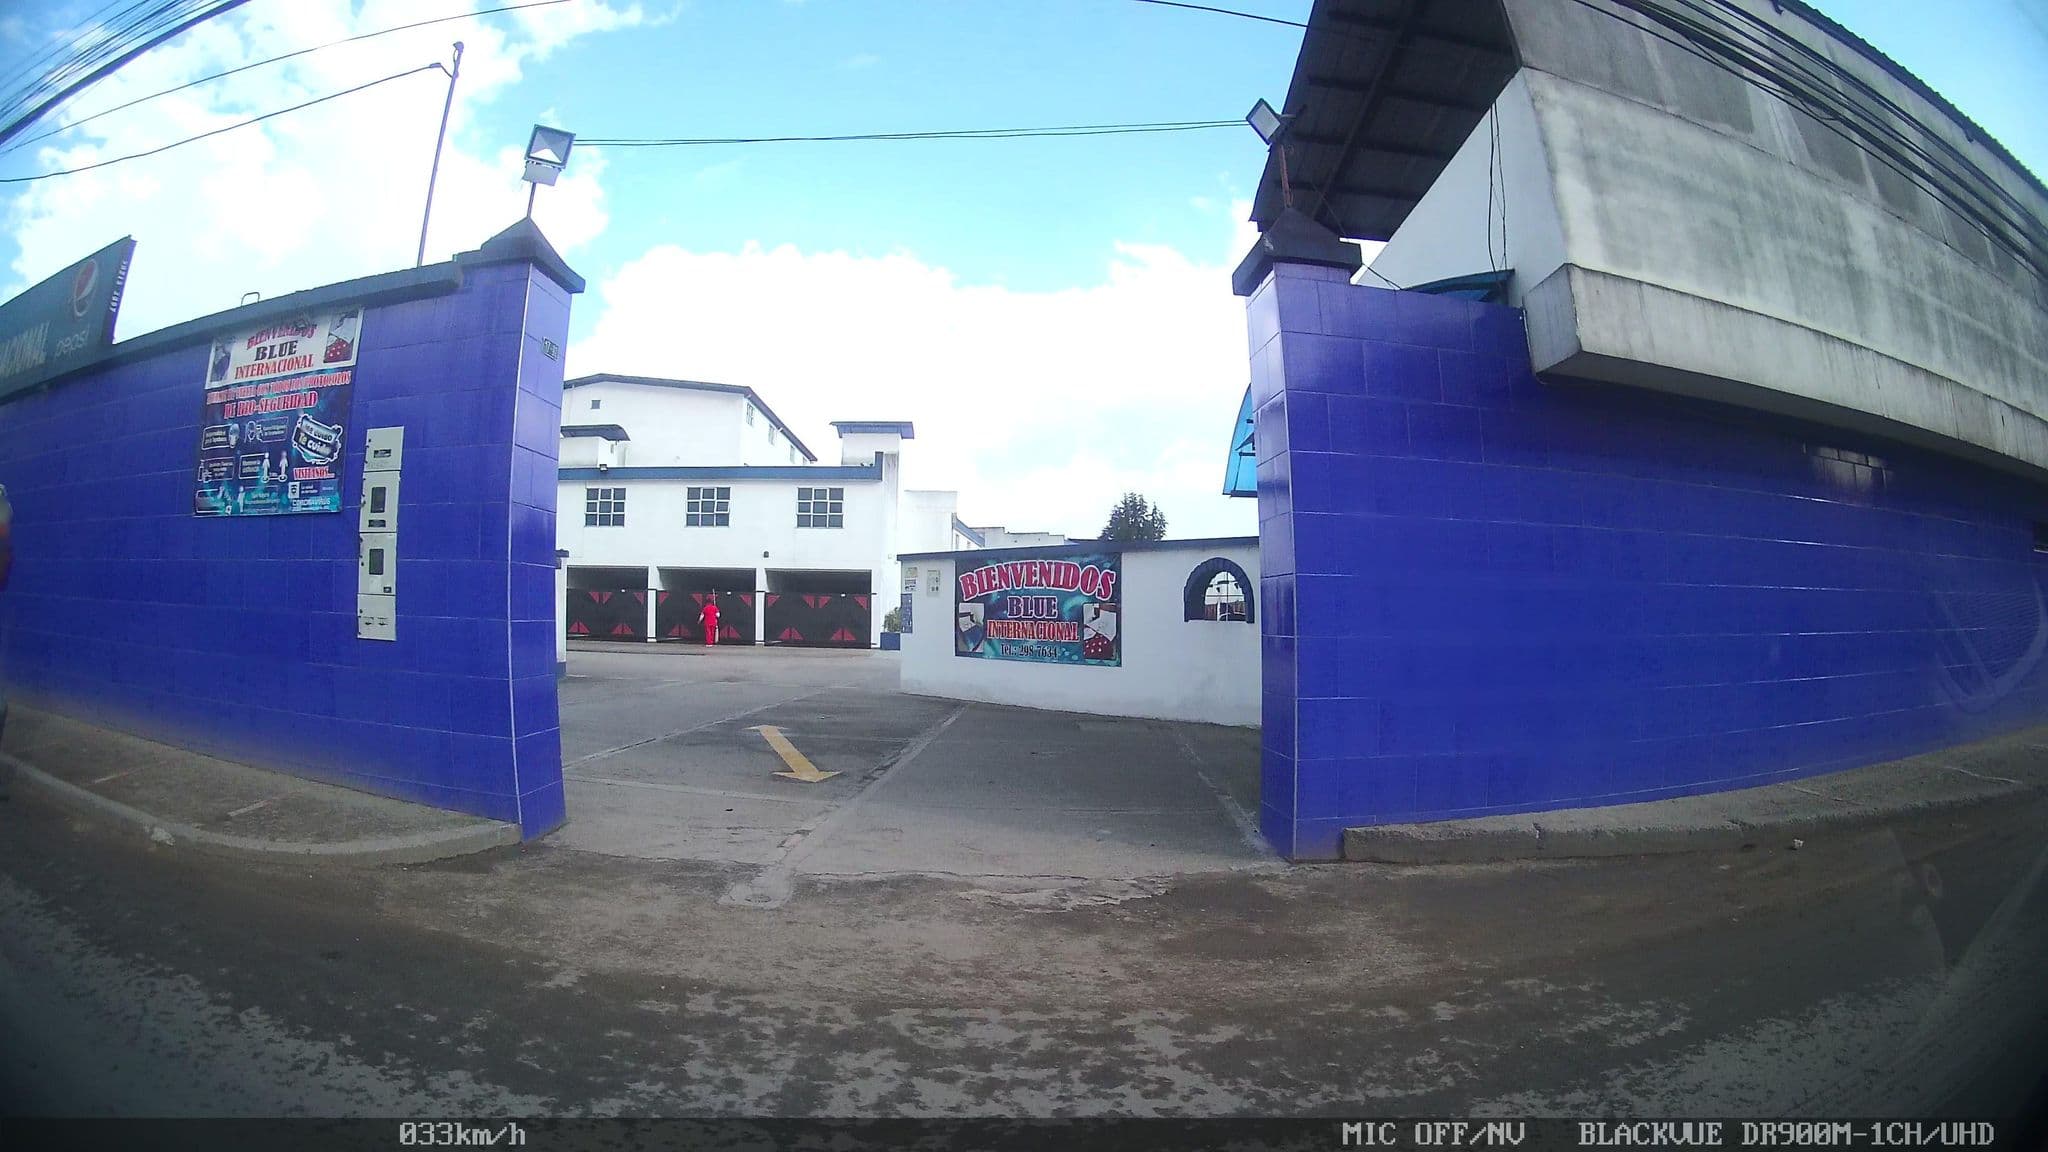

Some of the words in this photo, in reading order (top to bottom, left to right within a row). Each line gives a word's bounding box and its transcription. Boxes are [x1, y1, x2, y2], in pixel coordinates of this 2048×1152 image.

[254, 340, 298, 361] BLUE
[234, 354, 314, 380] INTERNACIONAL
[237, 391, 319, 416] BIO-SEGURIDAD
[958, 559, 1117, 601] BIENVENIDOS
[1007, 596, 1059, 619] BLUE
[986, 619, 1081, 642] INTERNACIONAL
